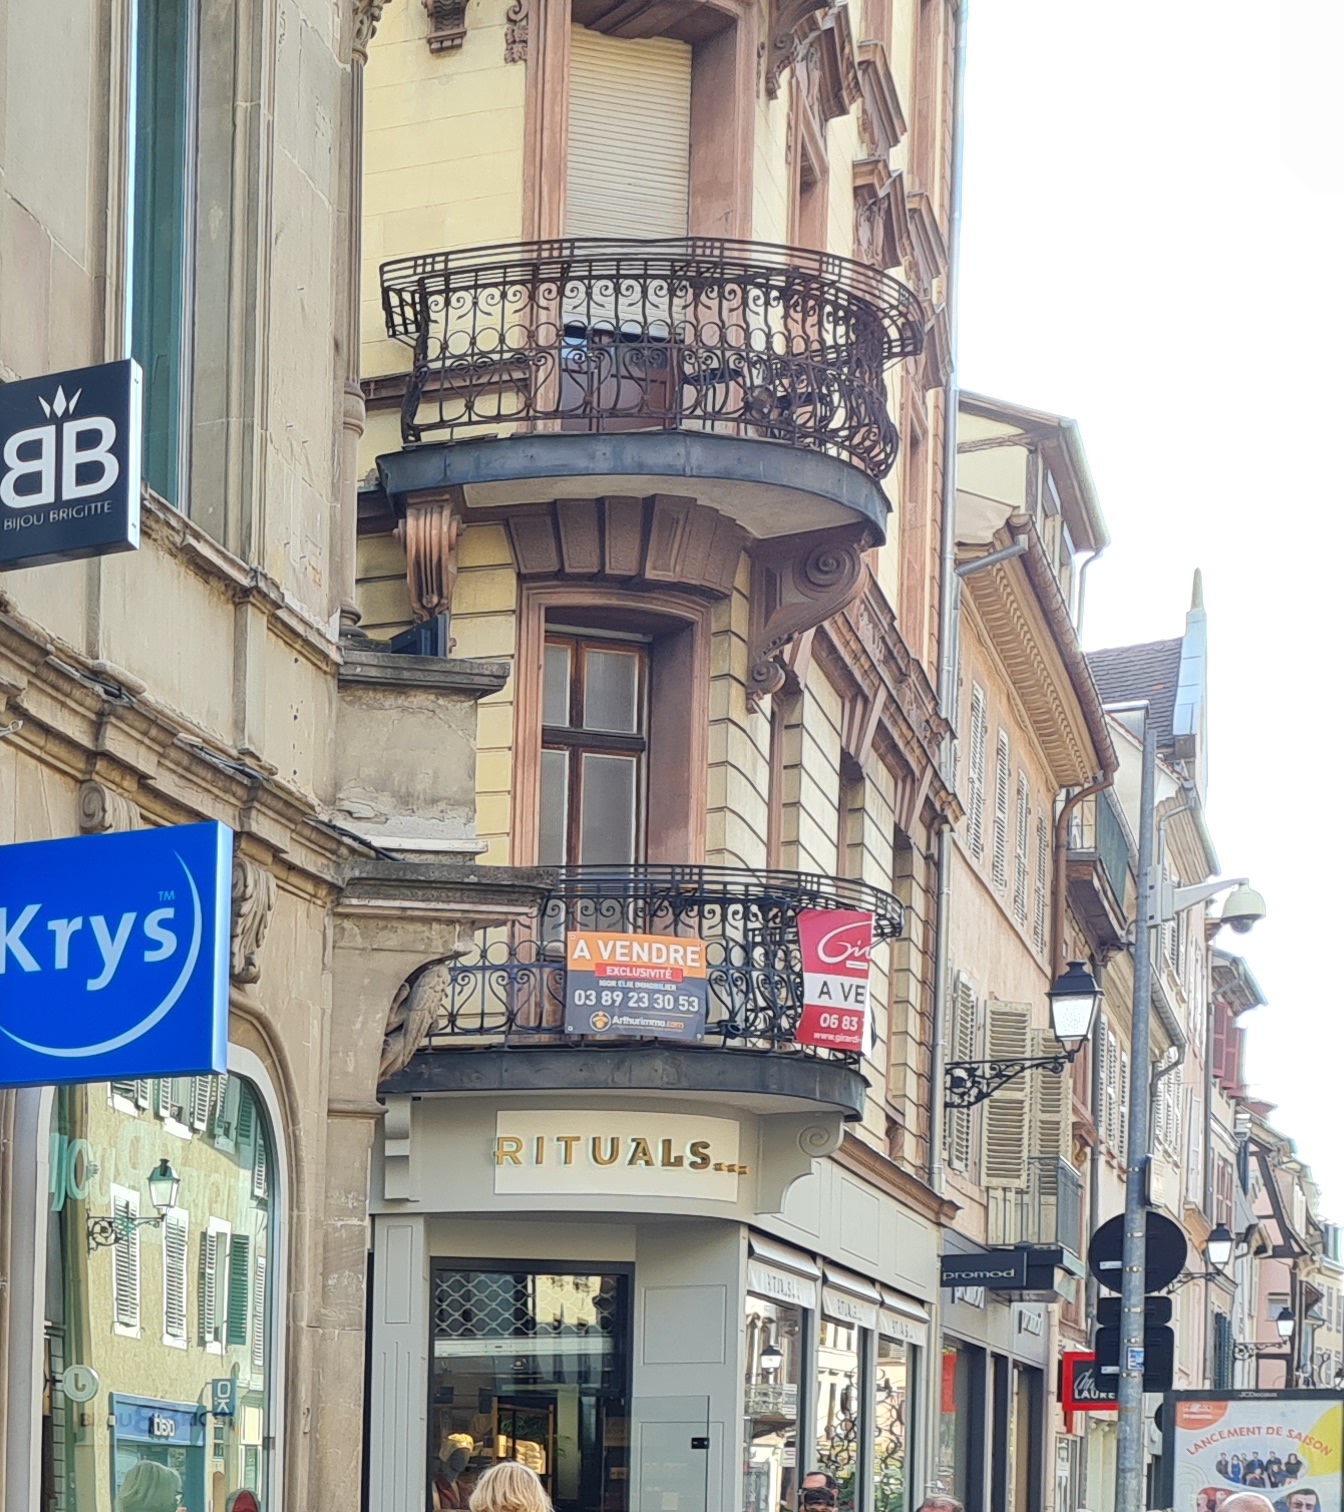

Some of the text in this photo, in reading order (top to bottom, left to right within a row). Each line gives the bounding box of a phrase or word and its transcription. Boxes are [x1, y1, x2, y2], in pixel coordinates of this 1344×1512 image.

[3, 500, 113, 532] BIJOU BRIGITTE
[572, 939, 701, 967] A VENDRE
[605, 966, 673, 980] EXCLUSIVITÉ
[574, 989, 699, 1012] 03 89 23 30 53
[818, 980, 832, 1000] A
[820, 1013, 859, 1031] 06 83
[943, 1268, 1015, 1281] promod
[1185, 1426, 1334, 1457] LANCEMENT DE SAISON
